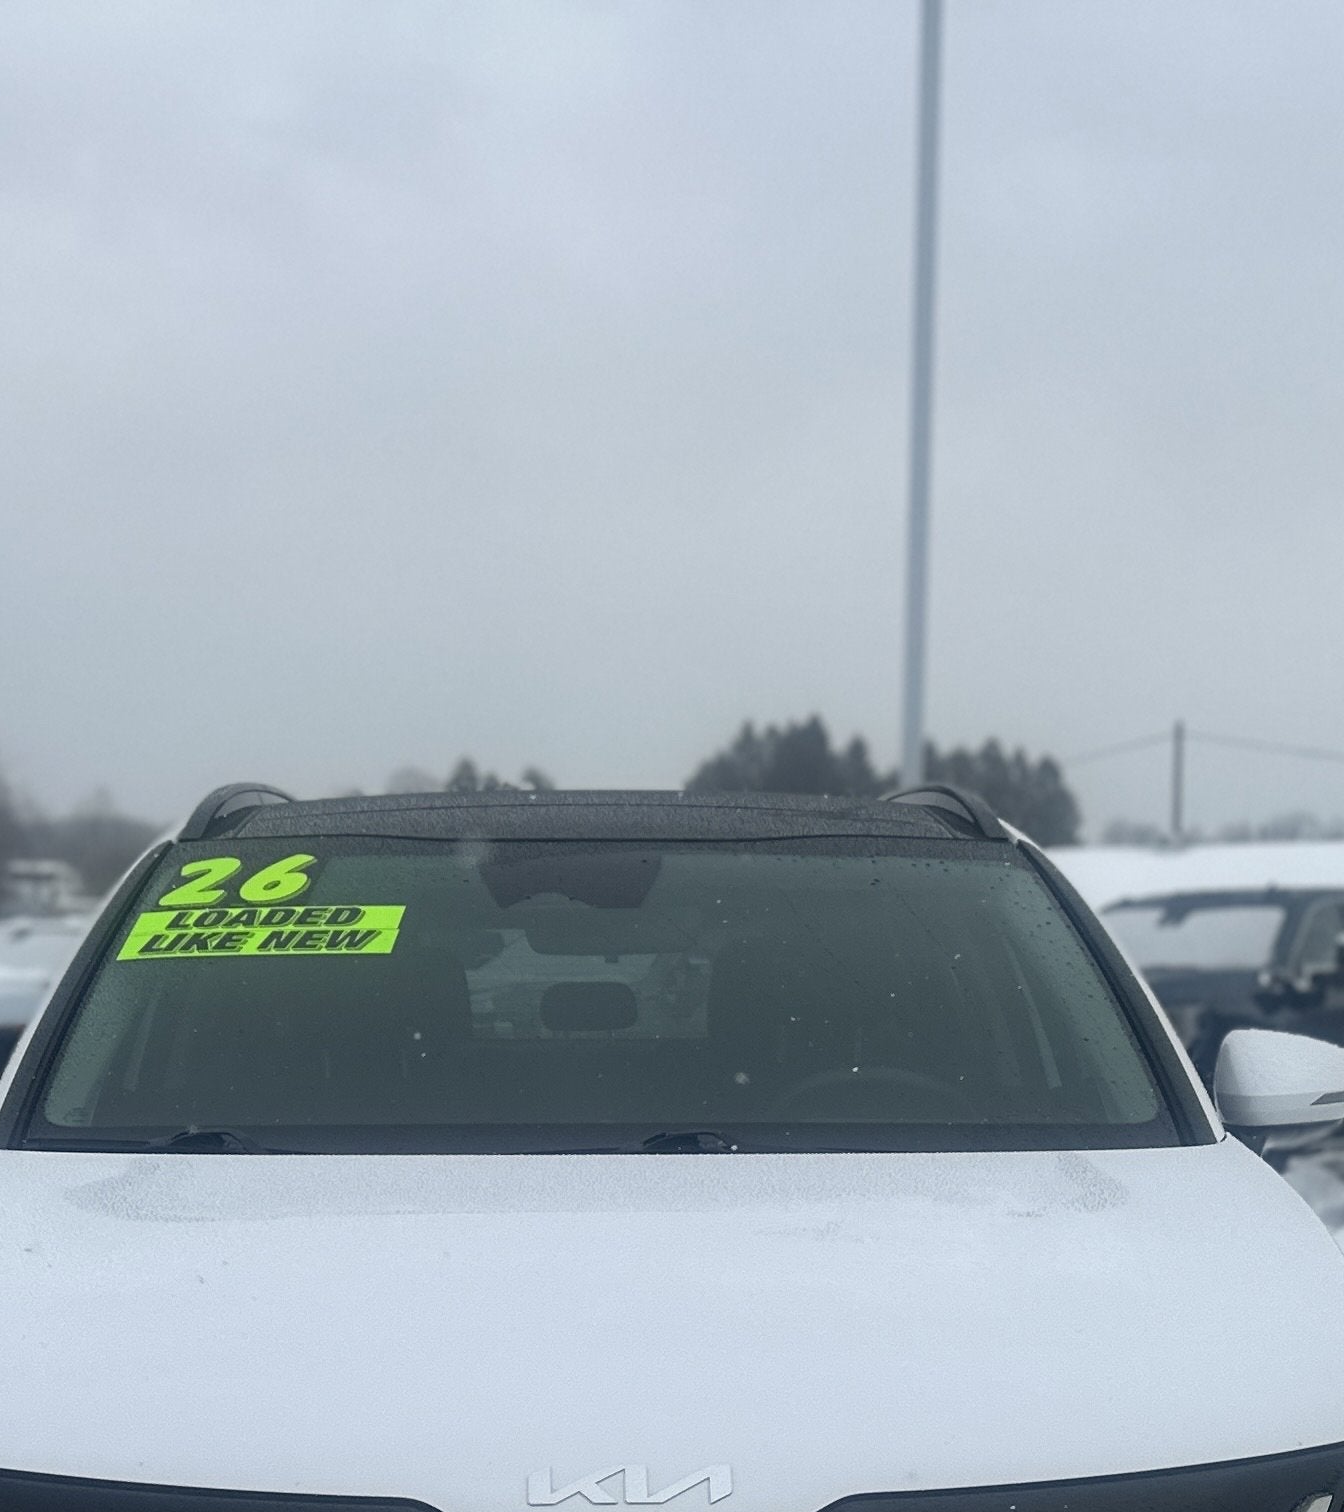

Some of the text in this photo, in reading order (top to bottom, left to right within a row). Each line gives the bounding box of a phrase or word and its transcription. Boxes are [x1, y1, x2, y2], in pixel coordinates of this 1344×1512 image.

[158, 854, 317, 906] 26
[165, 907, 366, 930] LOADED
[138, 928, 382, 955] LIKE NEW
[527, 1463, 732, 1506] KIA
